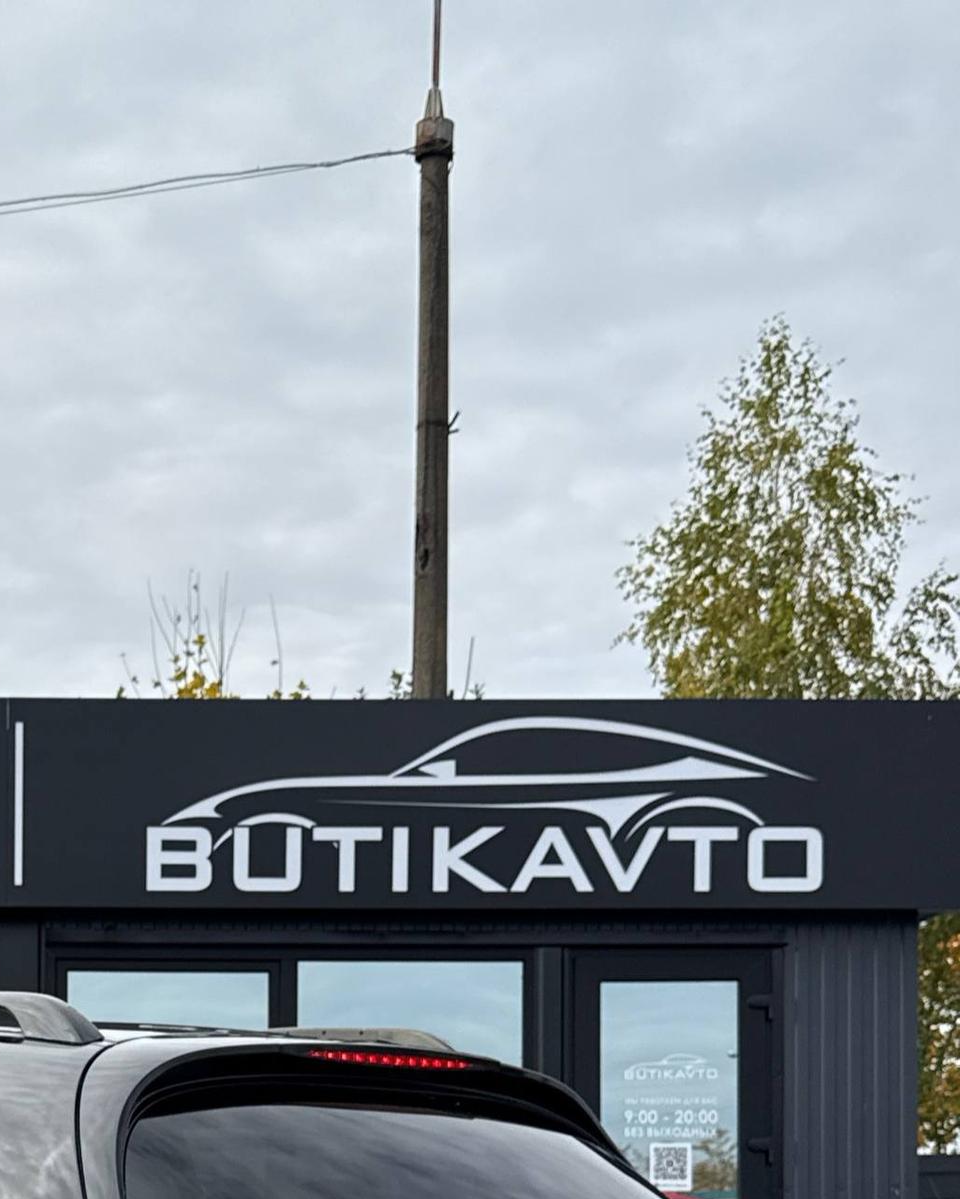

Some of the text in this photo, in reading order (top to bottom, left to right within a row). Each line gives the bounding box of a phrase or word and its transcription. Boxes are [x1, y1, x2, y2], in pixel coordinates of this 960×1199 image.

[145, 826, 823, 892] BUTIKAVTO
[624, 1068, 718, 1080] BUTIKAVTO
[624, 1109, 659, 1124] 9:00
[674, 1109, 719, 1124] 20:00
